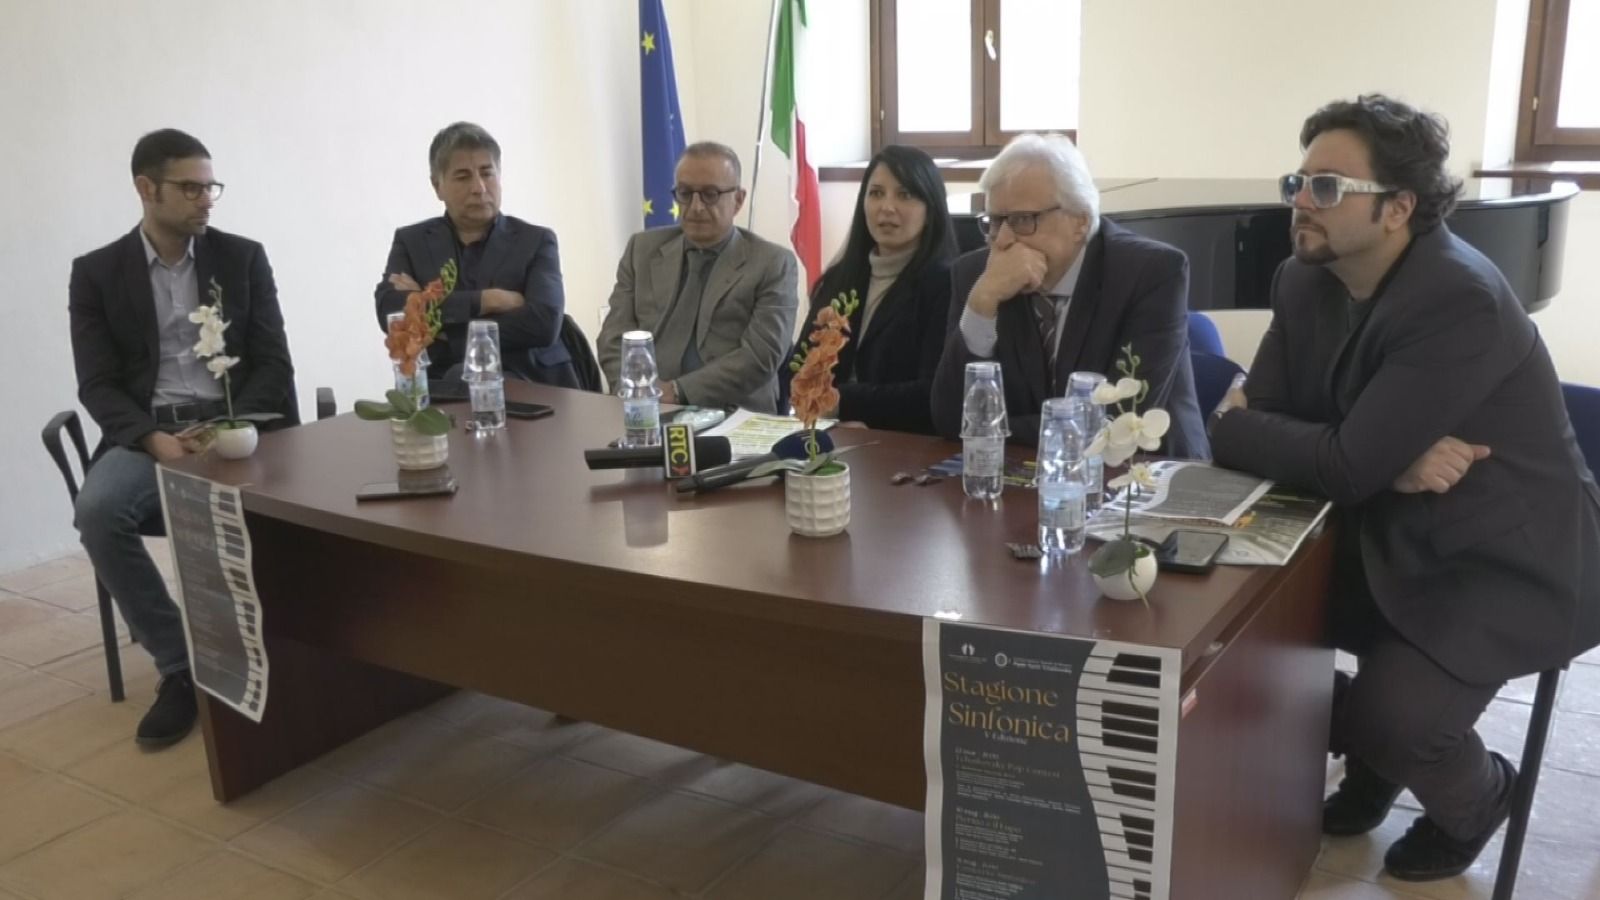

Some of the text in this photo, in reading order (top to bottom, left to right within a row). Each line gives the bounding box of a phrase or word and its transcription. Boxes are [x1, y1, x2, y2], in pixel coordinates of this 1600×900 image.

[669, 426, 688, 464] RTC
[944, 671, 1059, 707] Stagione
[948, 701, 1070, 743] Sinfonica
